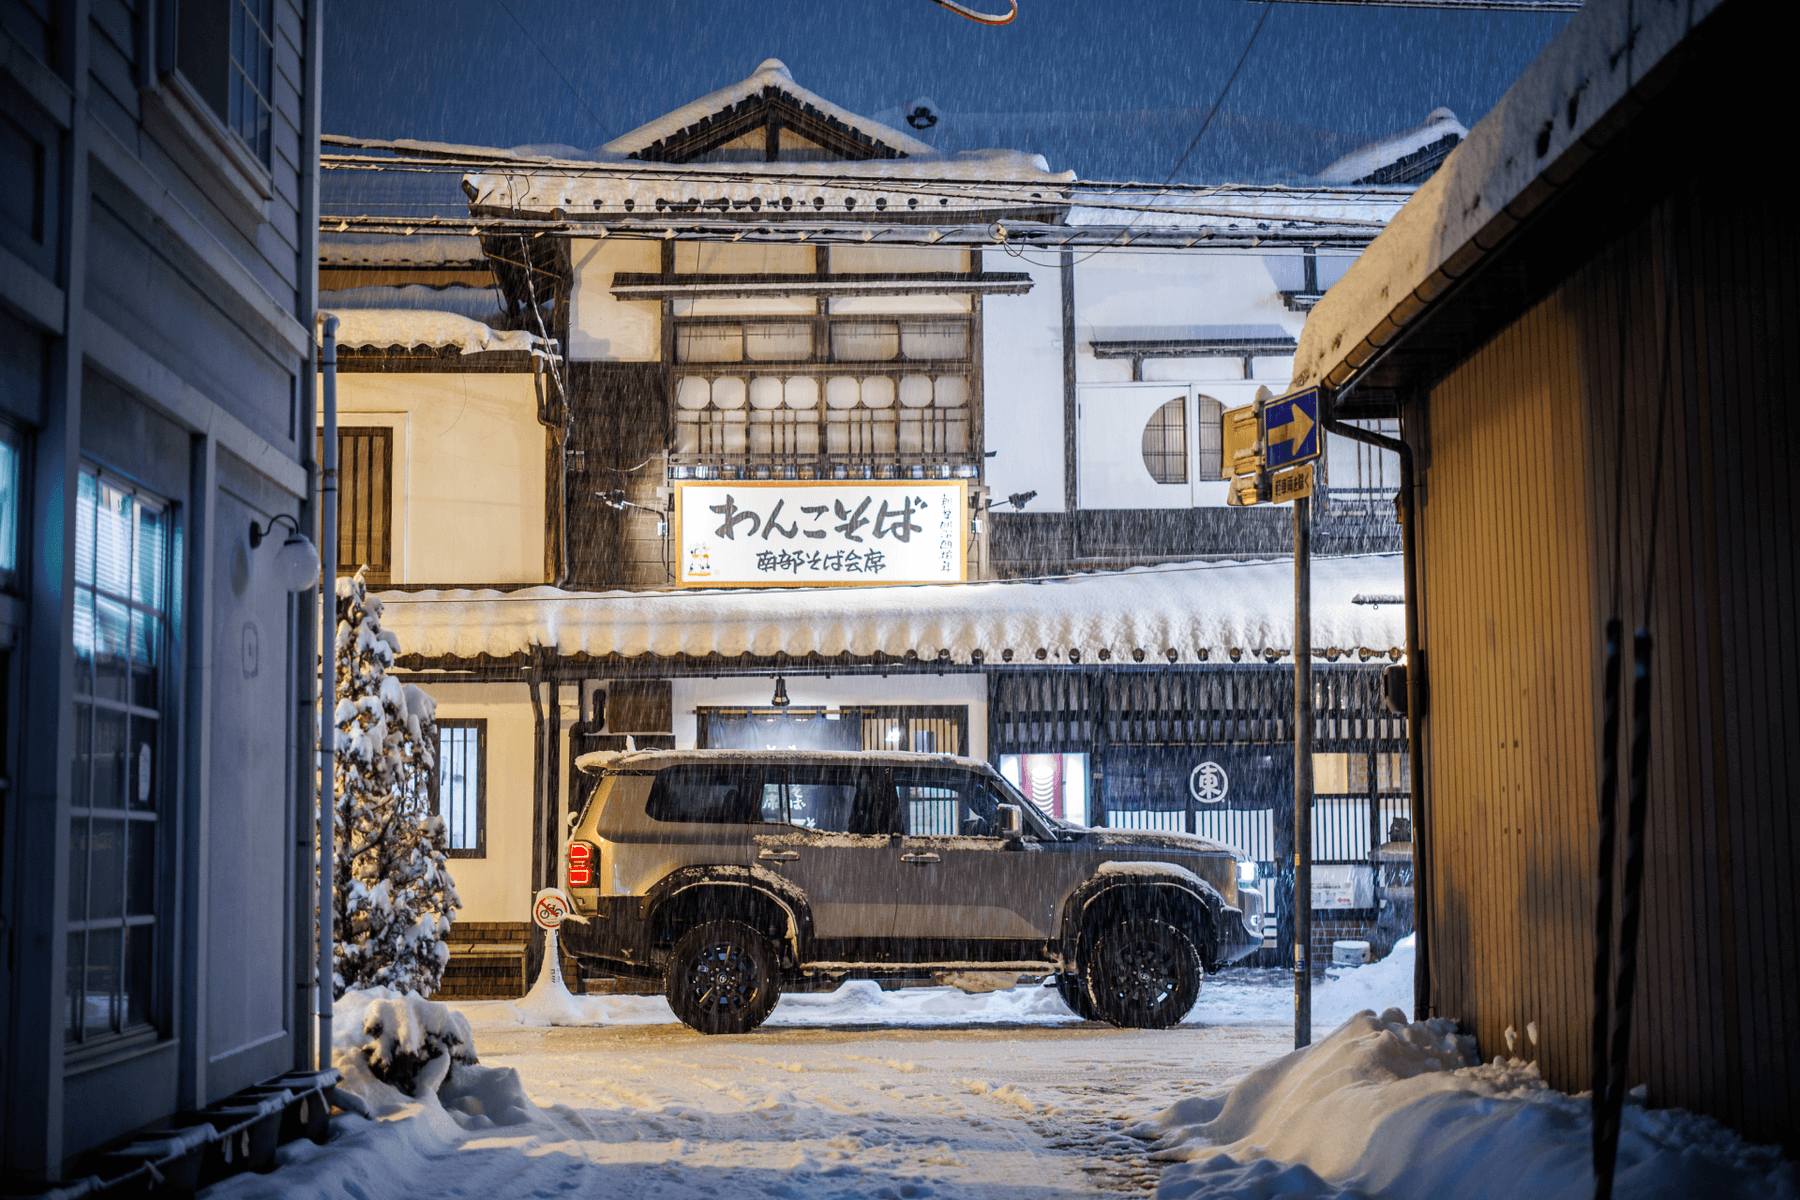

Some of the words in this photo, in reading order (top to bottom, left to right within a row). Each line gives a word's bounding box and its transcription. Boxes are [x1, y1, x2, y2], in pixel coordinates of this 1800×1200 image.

[709, 493, 928, 543] わんこそば
[756, 548, 886, 574] 南部そば会席
[1197, 764, 1222, 800] 東
